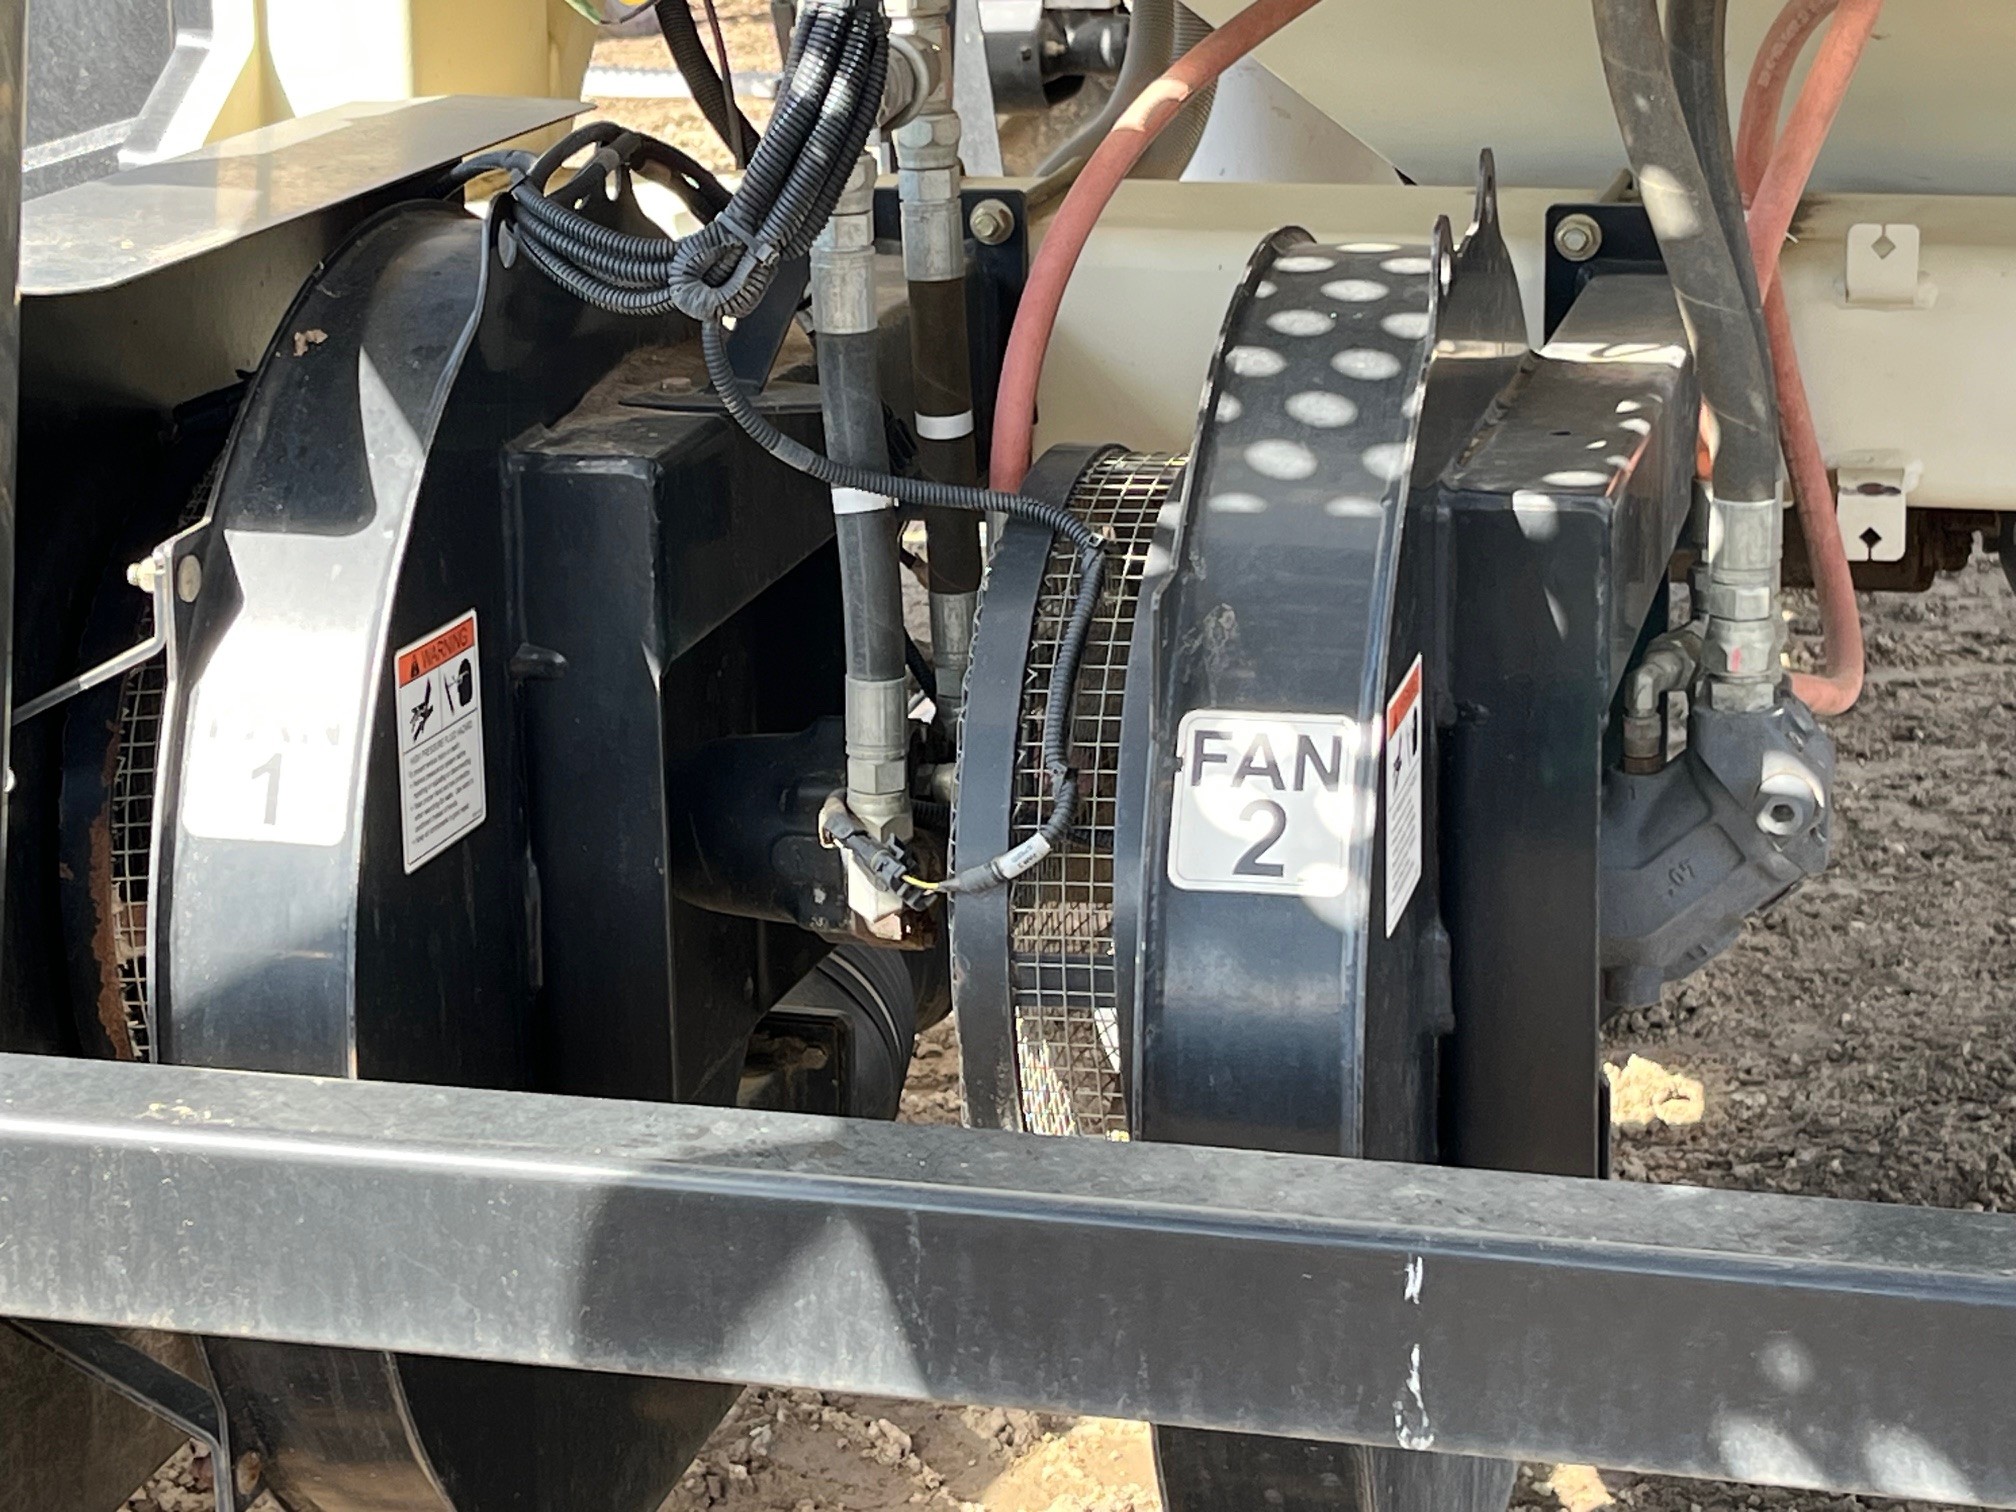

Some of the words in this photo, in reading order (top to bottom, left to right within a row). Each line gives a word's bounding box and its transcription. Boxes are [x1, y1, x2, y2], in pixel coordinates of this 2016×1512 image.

[421, 626, 468, 669] WARNING
[251, 752, 282, 826] 1
[1190, 729, 1343, 792] FAN
[1232, 799, 1288, 878] 2
